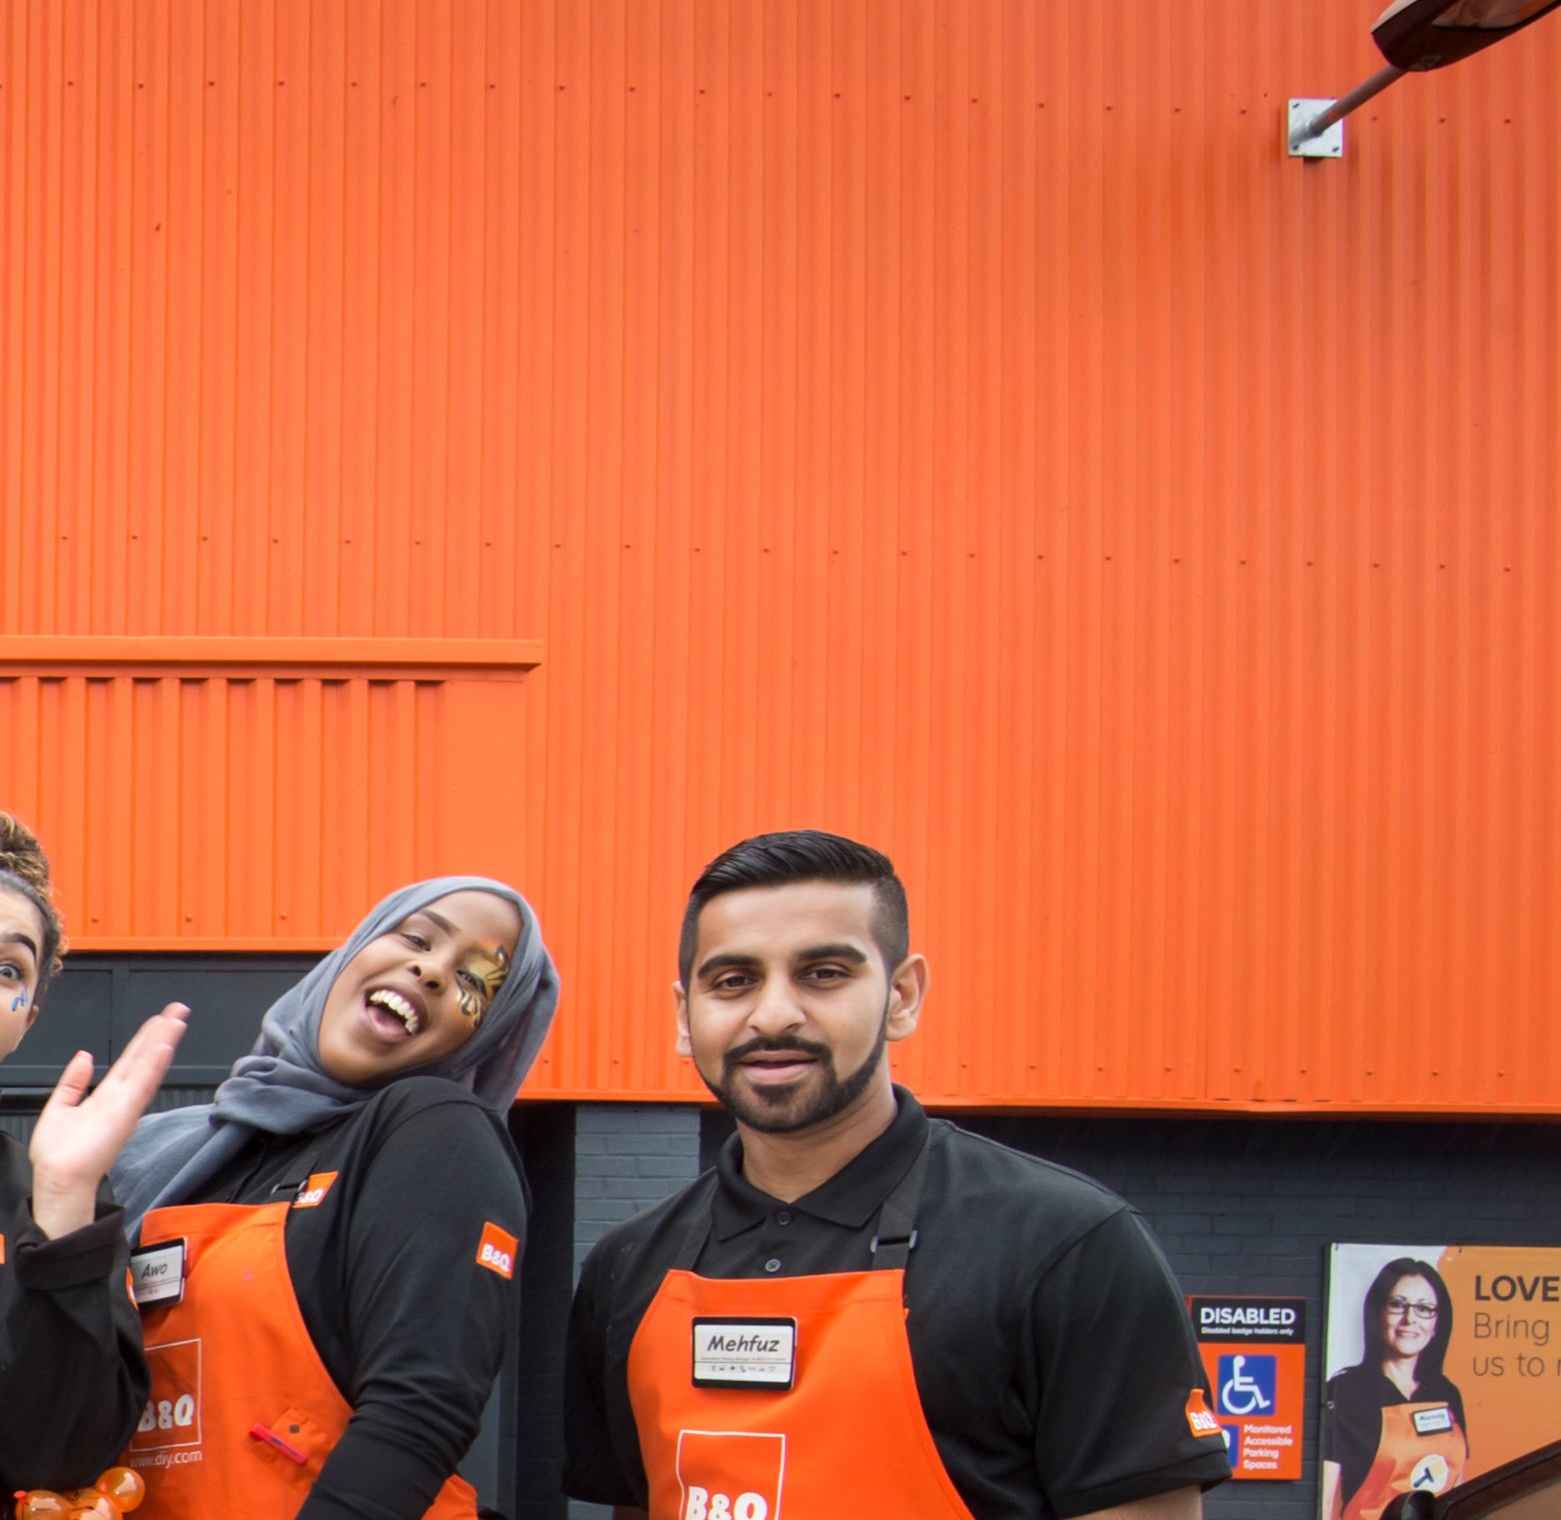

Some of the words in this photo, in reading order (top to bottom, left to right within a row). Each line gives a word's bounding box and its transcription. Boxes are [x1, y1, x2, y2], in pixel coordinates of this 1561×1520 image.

[481, 1243, 511, 1272] B&Q
[1474, 1275, 1561, 1302] LOVE
[1200, 1307, 1296, 1325] DISABLED
[1201, 1326, 1231, 1335] Disabled
[1231, 1327, 1253, 1336] badge
[1253, 1327, 1278, 1335] holders
[1279, 1328, 1295, 1336] only
[1474, 1312, 1550, 1347] Bring
[707, 1334, 780, 1352] Mehfuz
[1472, 1356, 1504, 1377] us
[1517, 1352, 1545, 1377] to
[1243, 1424, 1292, 1434] Monitored
[1243, 1436, 1294, 1446] Accessible
[129, 1450, 203, 1469] www.diy.com
[1243, 1448, 1279, 1459] Parking
[1243, 1459, 1278, 1471] Spaces
